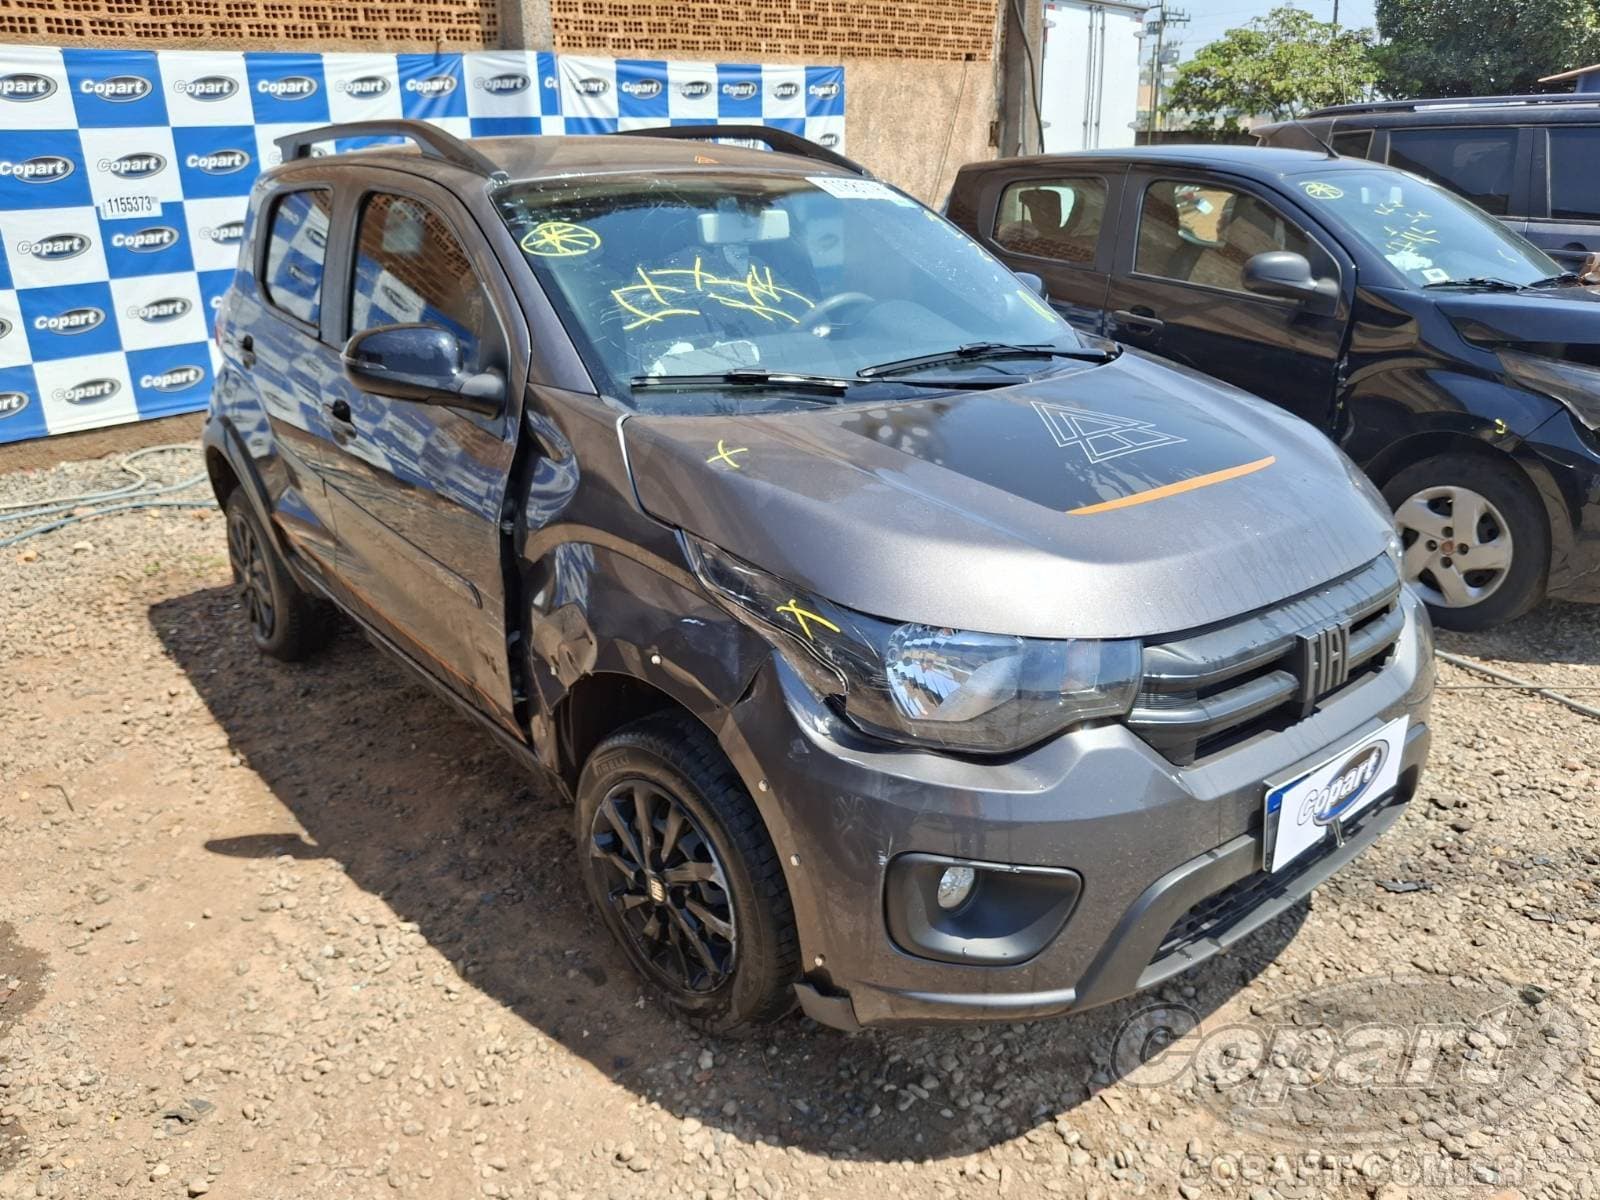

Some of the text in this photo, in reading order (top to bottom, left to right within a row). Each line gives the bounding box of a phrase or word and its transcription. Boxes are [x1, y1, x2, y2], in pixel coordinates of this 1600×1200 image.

[0, 79, 46, 95] part
[80, 79, 143, 97] Copart
[174, 79, 229, 96] Copart
[257, 79, 309, 95] Copart
[406, 77, 450, 94] Copart
[473, 76, 523, 92] Copart
[622, 81, 658, 95] Copart
[722, 83, 754, 95] Copart
[0, 161, 64, 177] Copart
[98, 157, 157, 175] Copart
[186, 153, 241, 172] Copart
[107, 195, 152, 213] 1155373
[17, 237, 82, 256] Copart
[112, 231, 171, 250] Copart
[127, 300, 184, 320] Copart
[34, 310, 97, 331] Copart
[140, 370, 196, 389] Copart
[52, 383, 113, 403] Copart
[1306, 619, 1353, 702] FIAT
[1297, 746, 1381, 826] Copart
